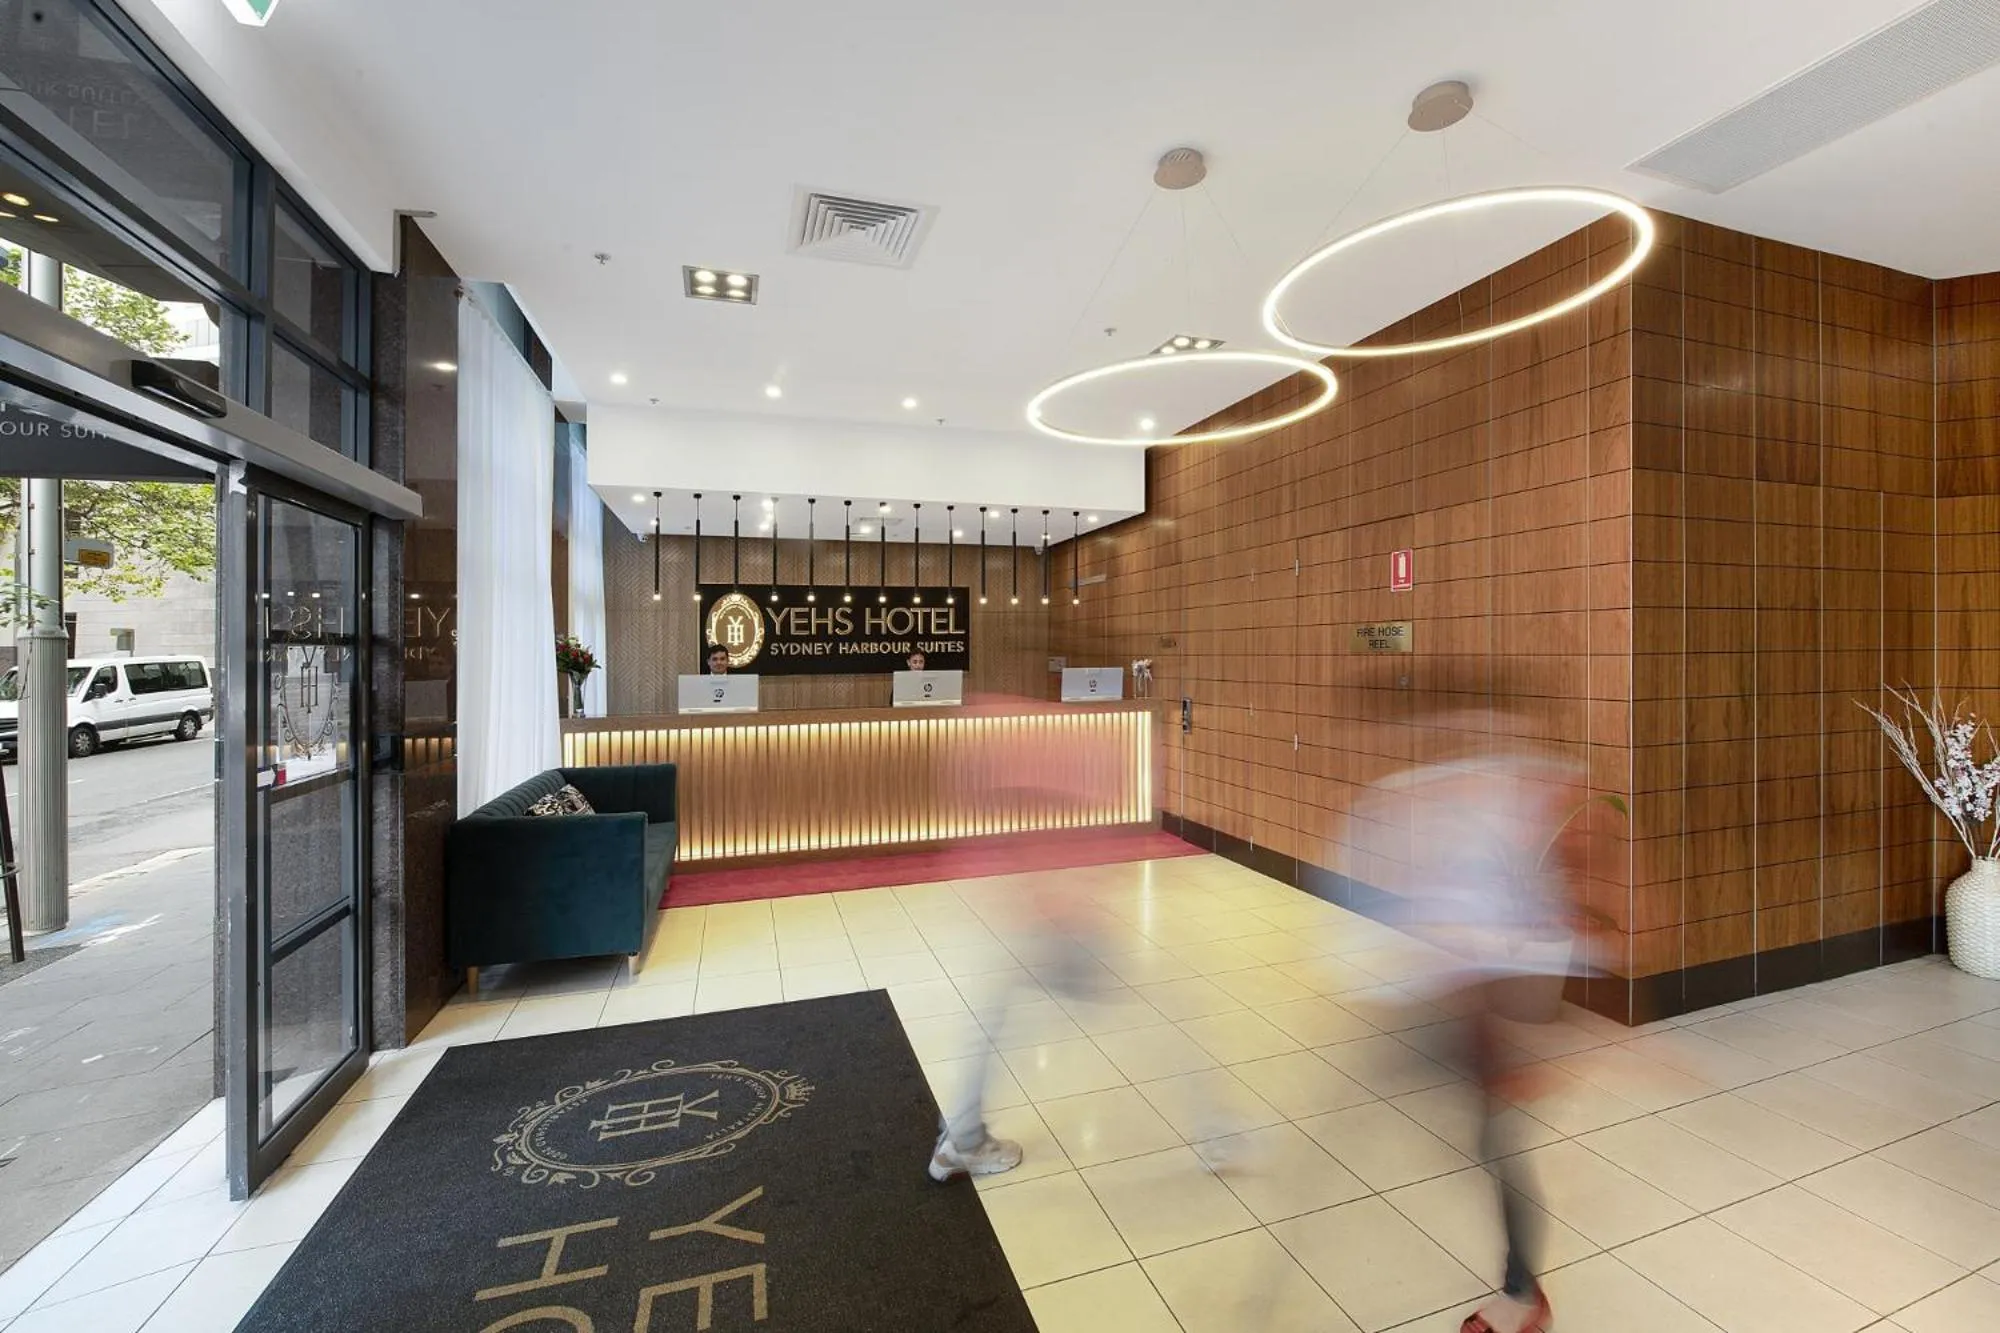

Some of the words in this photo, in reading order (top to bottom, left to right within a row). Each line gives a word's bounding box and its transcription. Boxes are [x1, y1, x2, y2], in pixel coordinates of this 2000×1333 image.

[765, 607, 855, 636] YEHS
[865, 606, 966, 636] HOTEL
[1378, 625, 1405, 637] HOSE
[770, 642, 834, 656] SYDNEY
[839, 641, 912, 655] HARBOUR
[916, 640, 966, 654] SUITES
[1368, 639, 1392, 649] REEL
